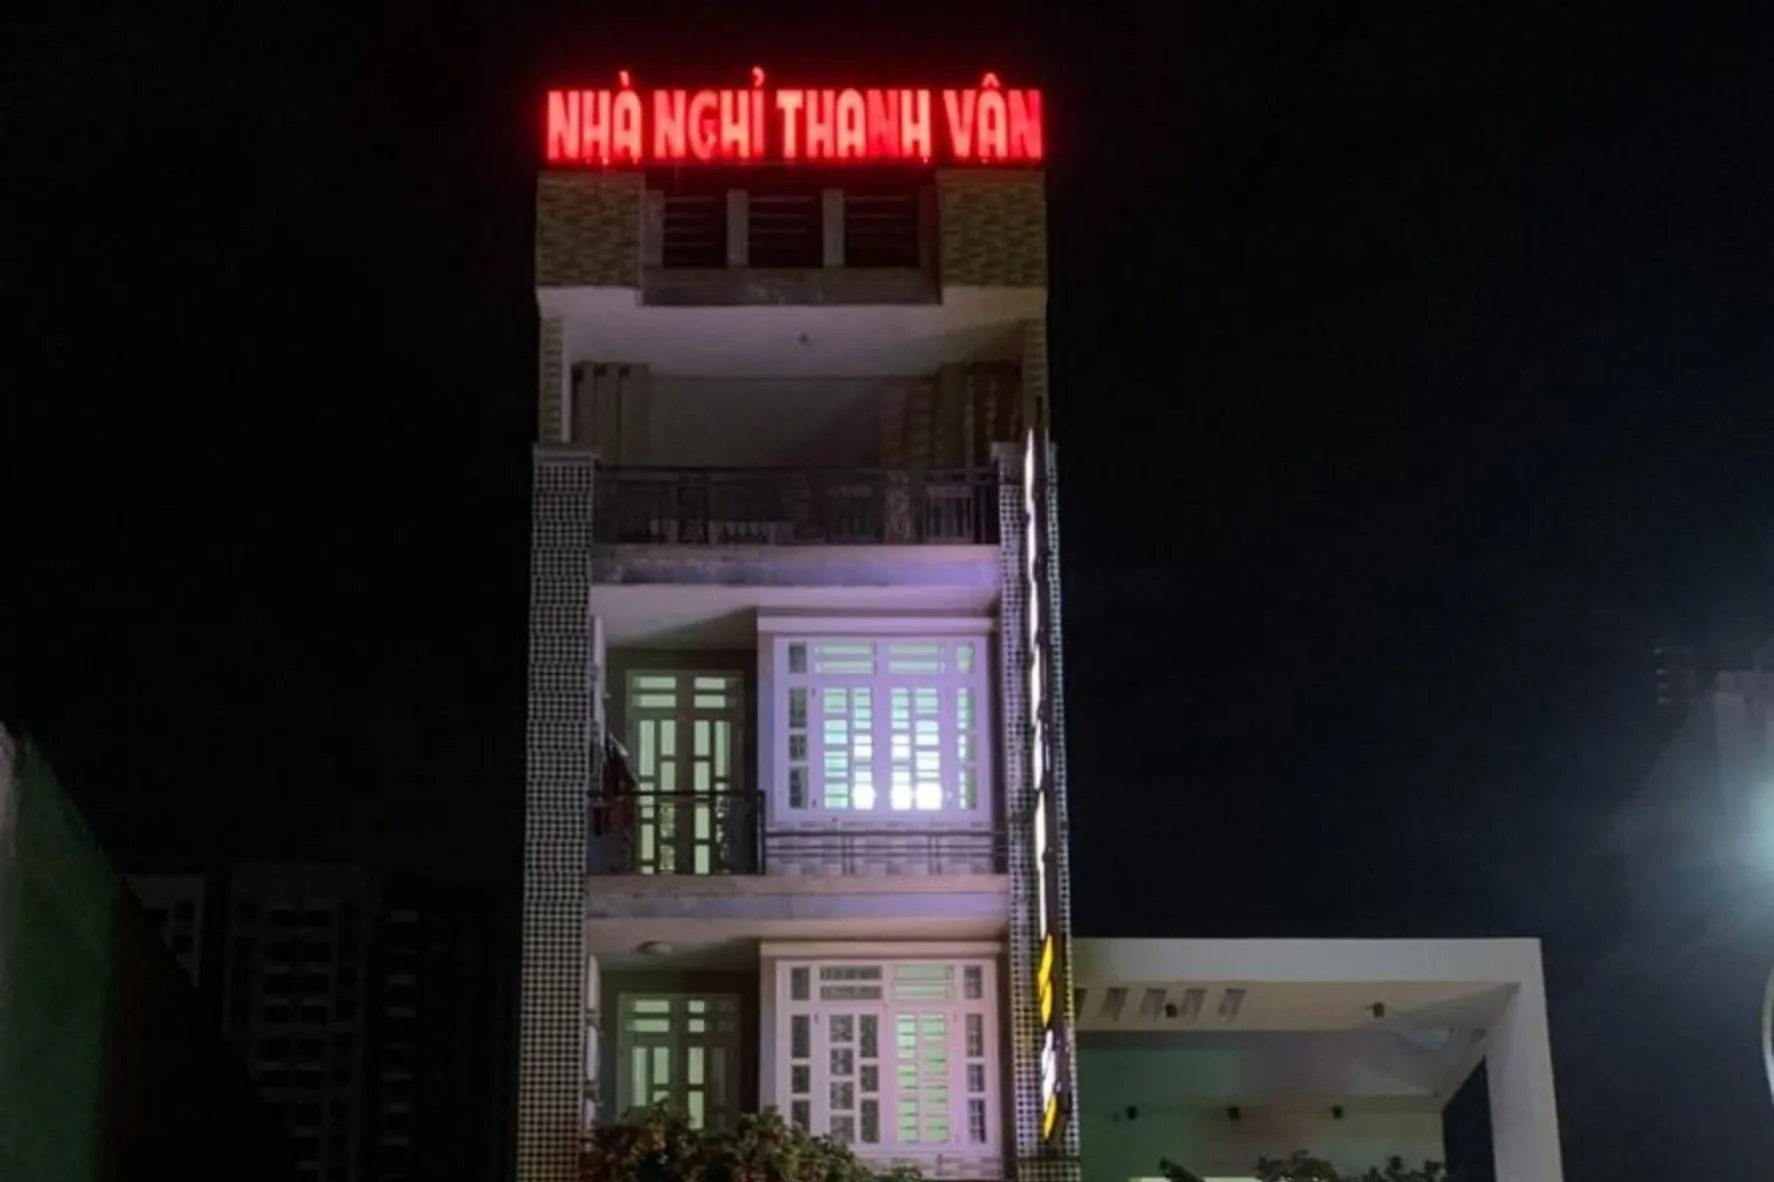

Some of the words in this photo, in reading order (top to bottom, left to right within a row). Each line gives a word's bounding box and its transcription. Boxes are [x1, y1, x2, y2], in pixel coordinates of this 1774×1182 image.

[548, 70, 642, 160] NHÀ
[654, 66, 766, 160] NGHỈ
[776, 88, 931, 160] THANH
[943, 72, 1043, 159] VÂN
